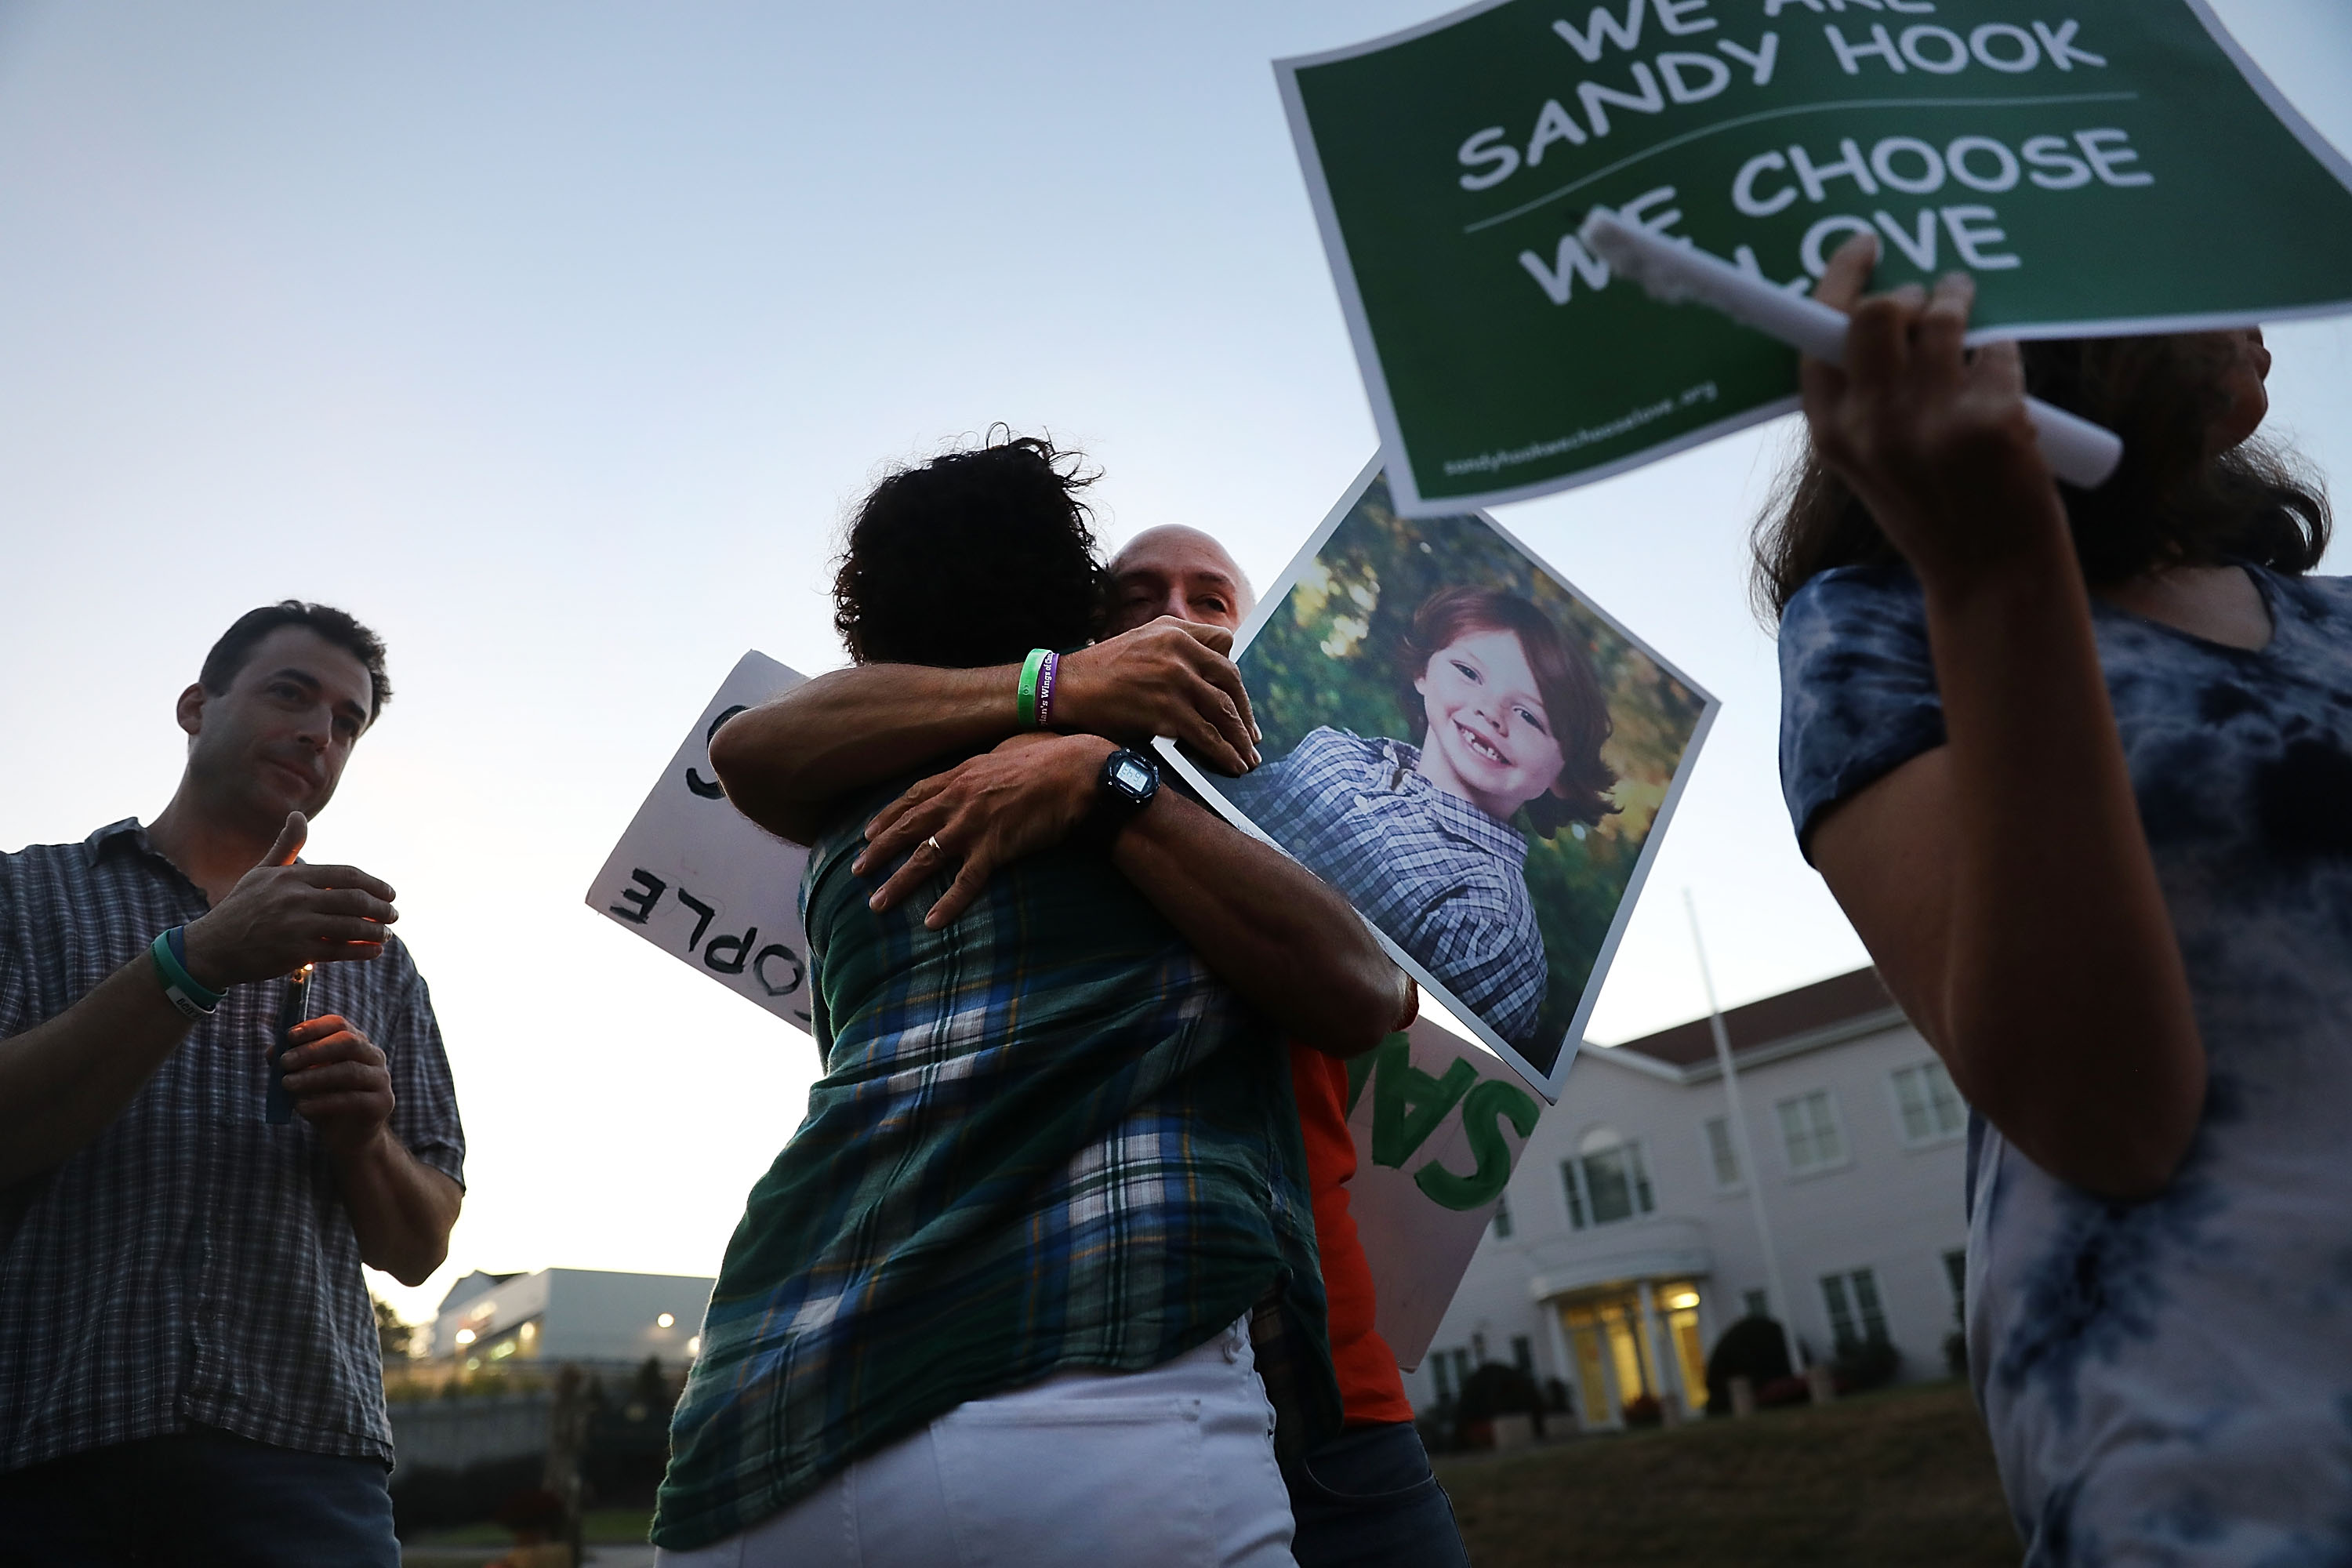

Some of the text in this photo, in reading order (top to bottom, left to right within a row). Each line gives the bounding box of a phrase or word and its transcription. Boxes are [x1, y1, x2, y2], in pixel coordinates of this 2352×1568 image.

[1552, 0, 1718, 63] WE
[1457, 18, 2108, 191] SANDY HOOK
[1731, 128, 2155, 217] CHOOSE
[1040, 672, 1052, 698] Wings
[609, 867, 811, 1022] OPLE
